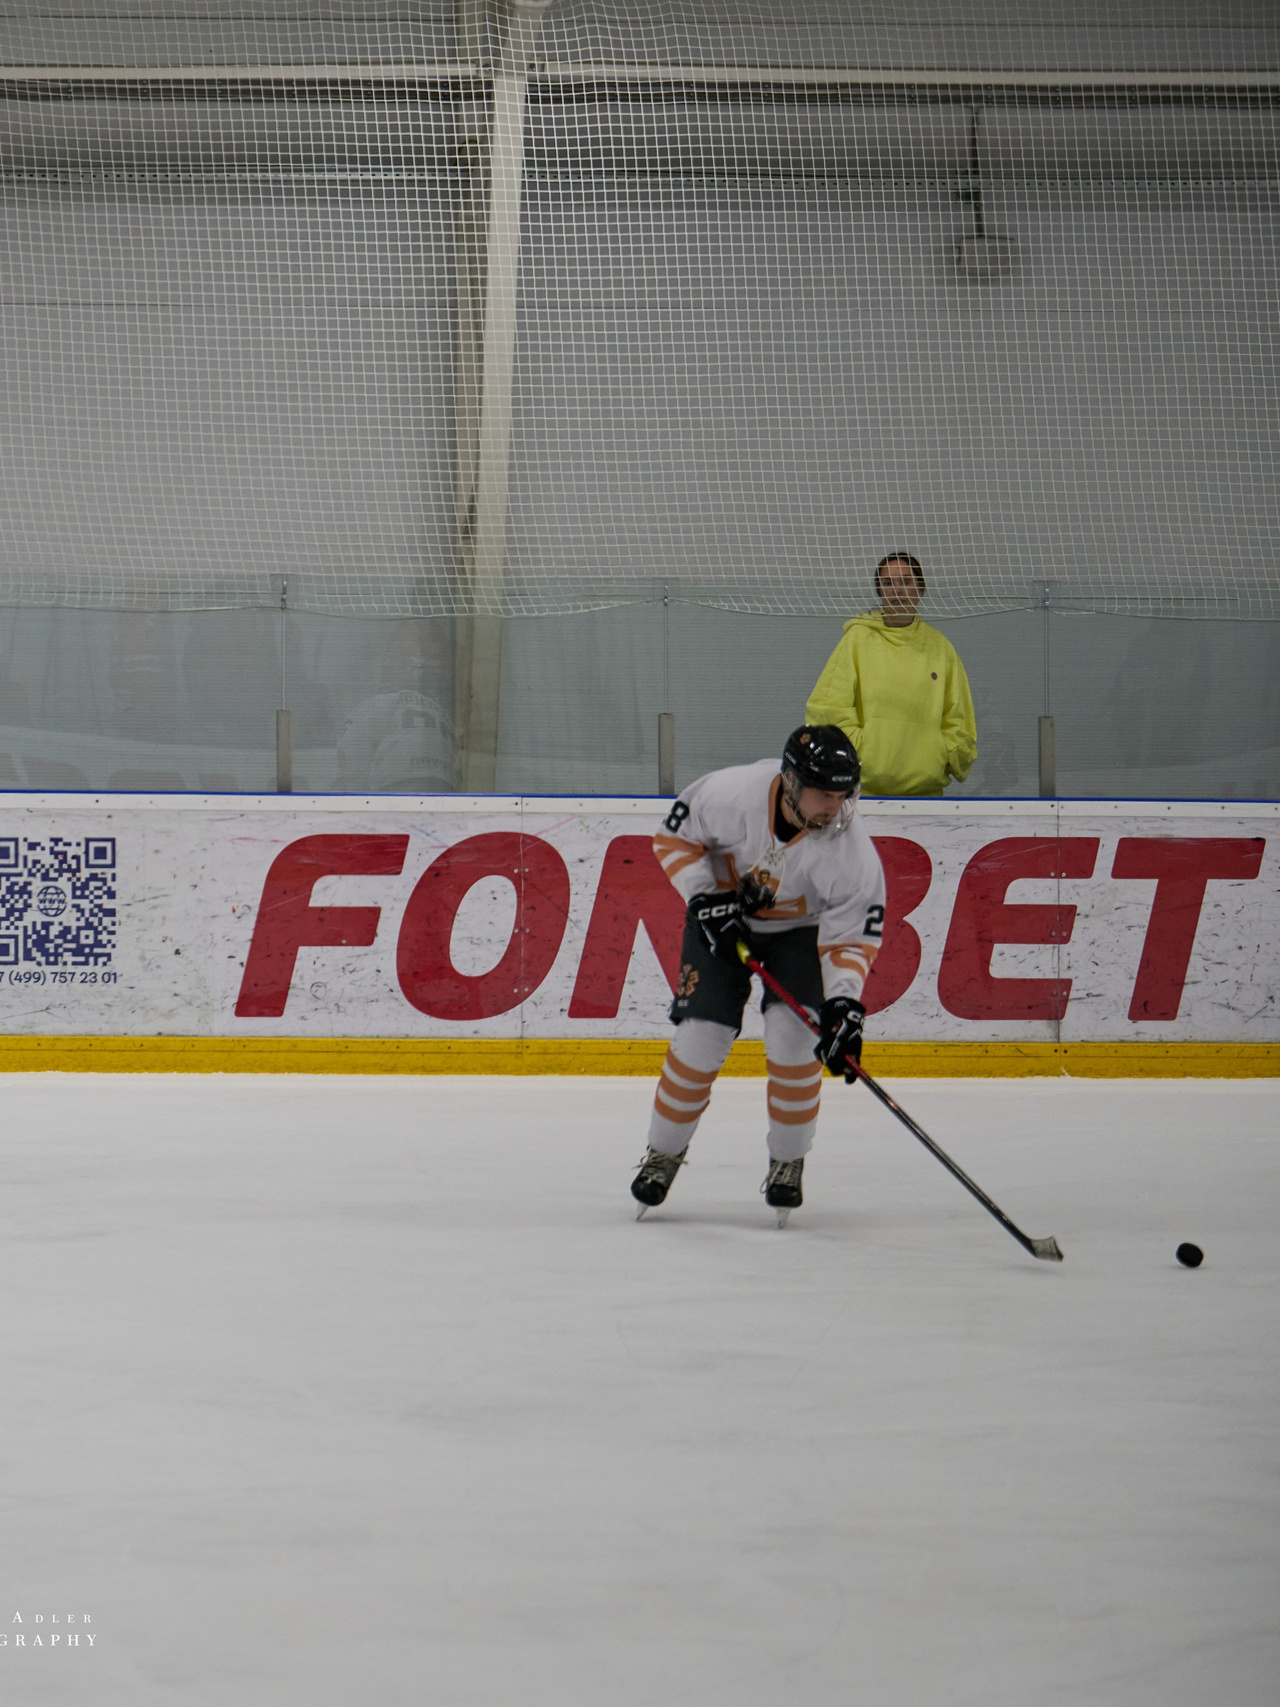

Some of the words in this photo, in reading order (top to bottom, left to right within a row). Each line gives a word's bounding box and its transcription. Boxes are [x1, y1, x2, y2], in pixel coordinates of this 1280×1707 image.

[8, 970, 47, 985] (499)
[50, 971, 76, 984] 757
[79, 971, 98, 984] 23
[101, 971, 118, 984] 01
